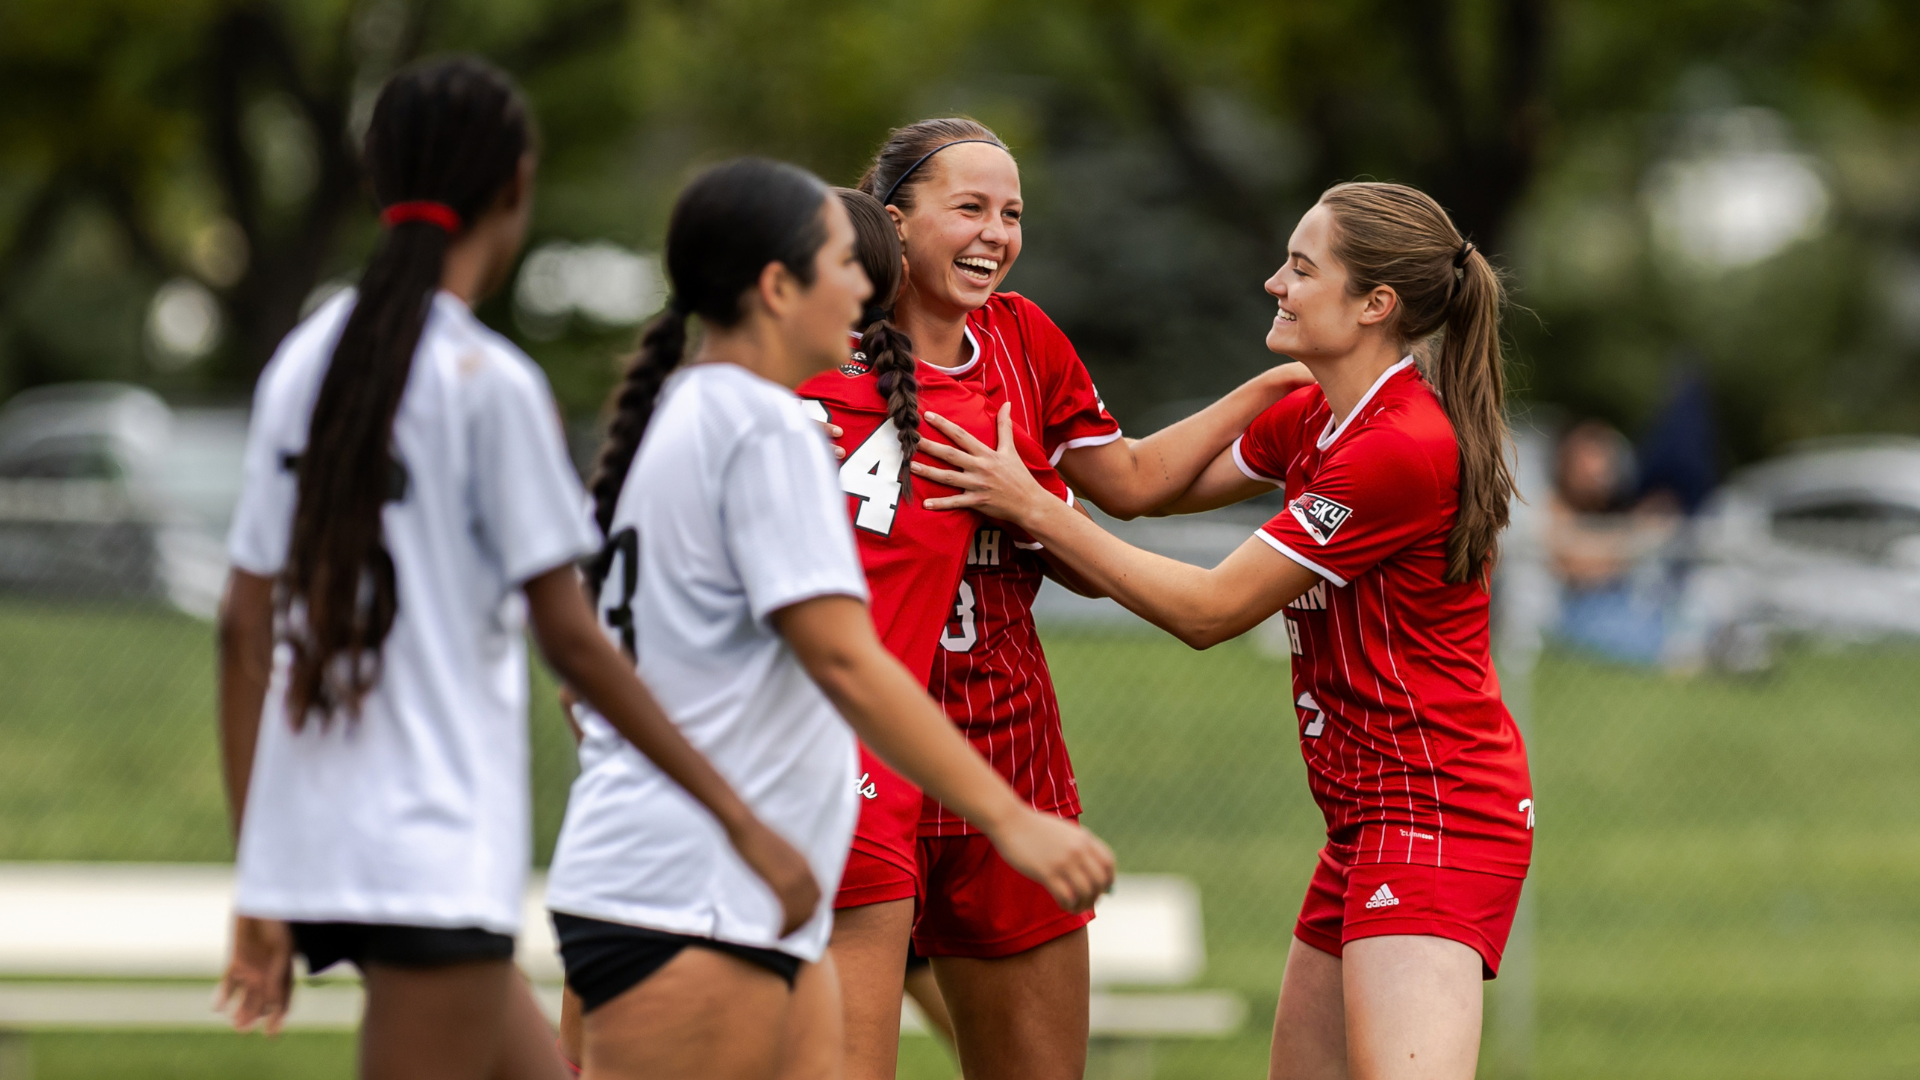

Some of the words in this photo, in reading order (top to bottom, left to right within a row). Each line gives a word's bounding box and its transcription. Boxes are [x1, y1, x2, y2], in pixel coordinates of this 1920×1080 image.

[1297, 495, 1317, 511] BIG
[1308, 499, 1347, 529] SKY
[1365, 894, 1399, 910] adidas
